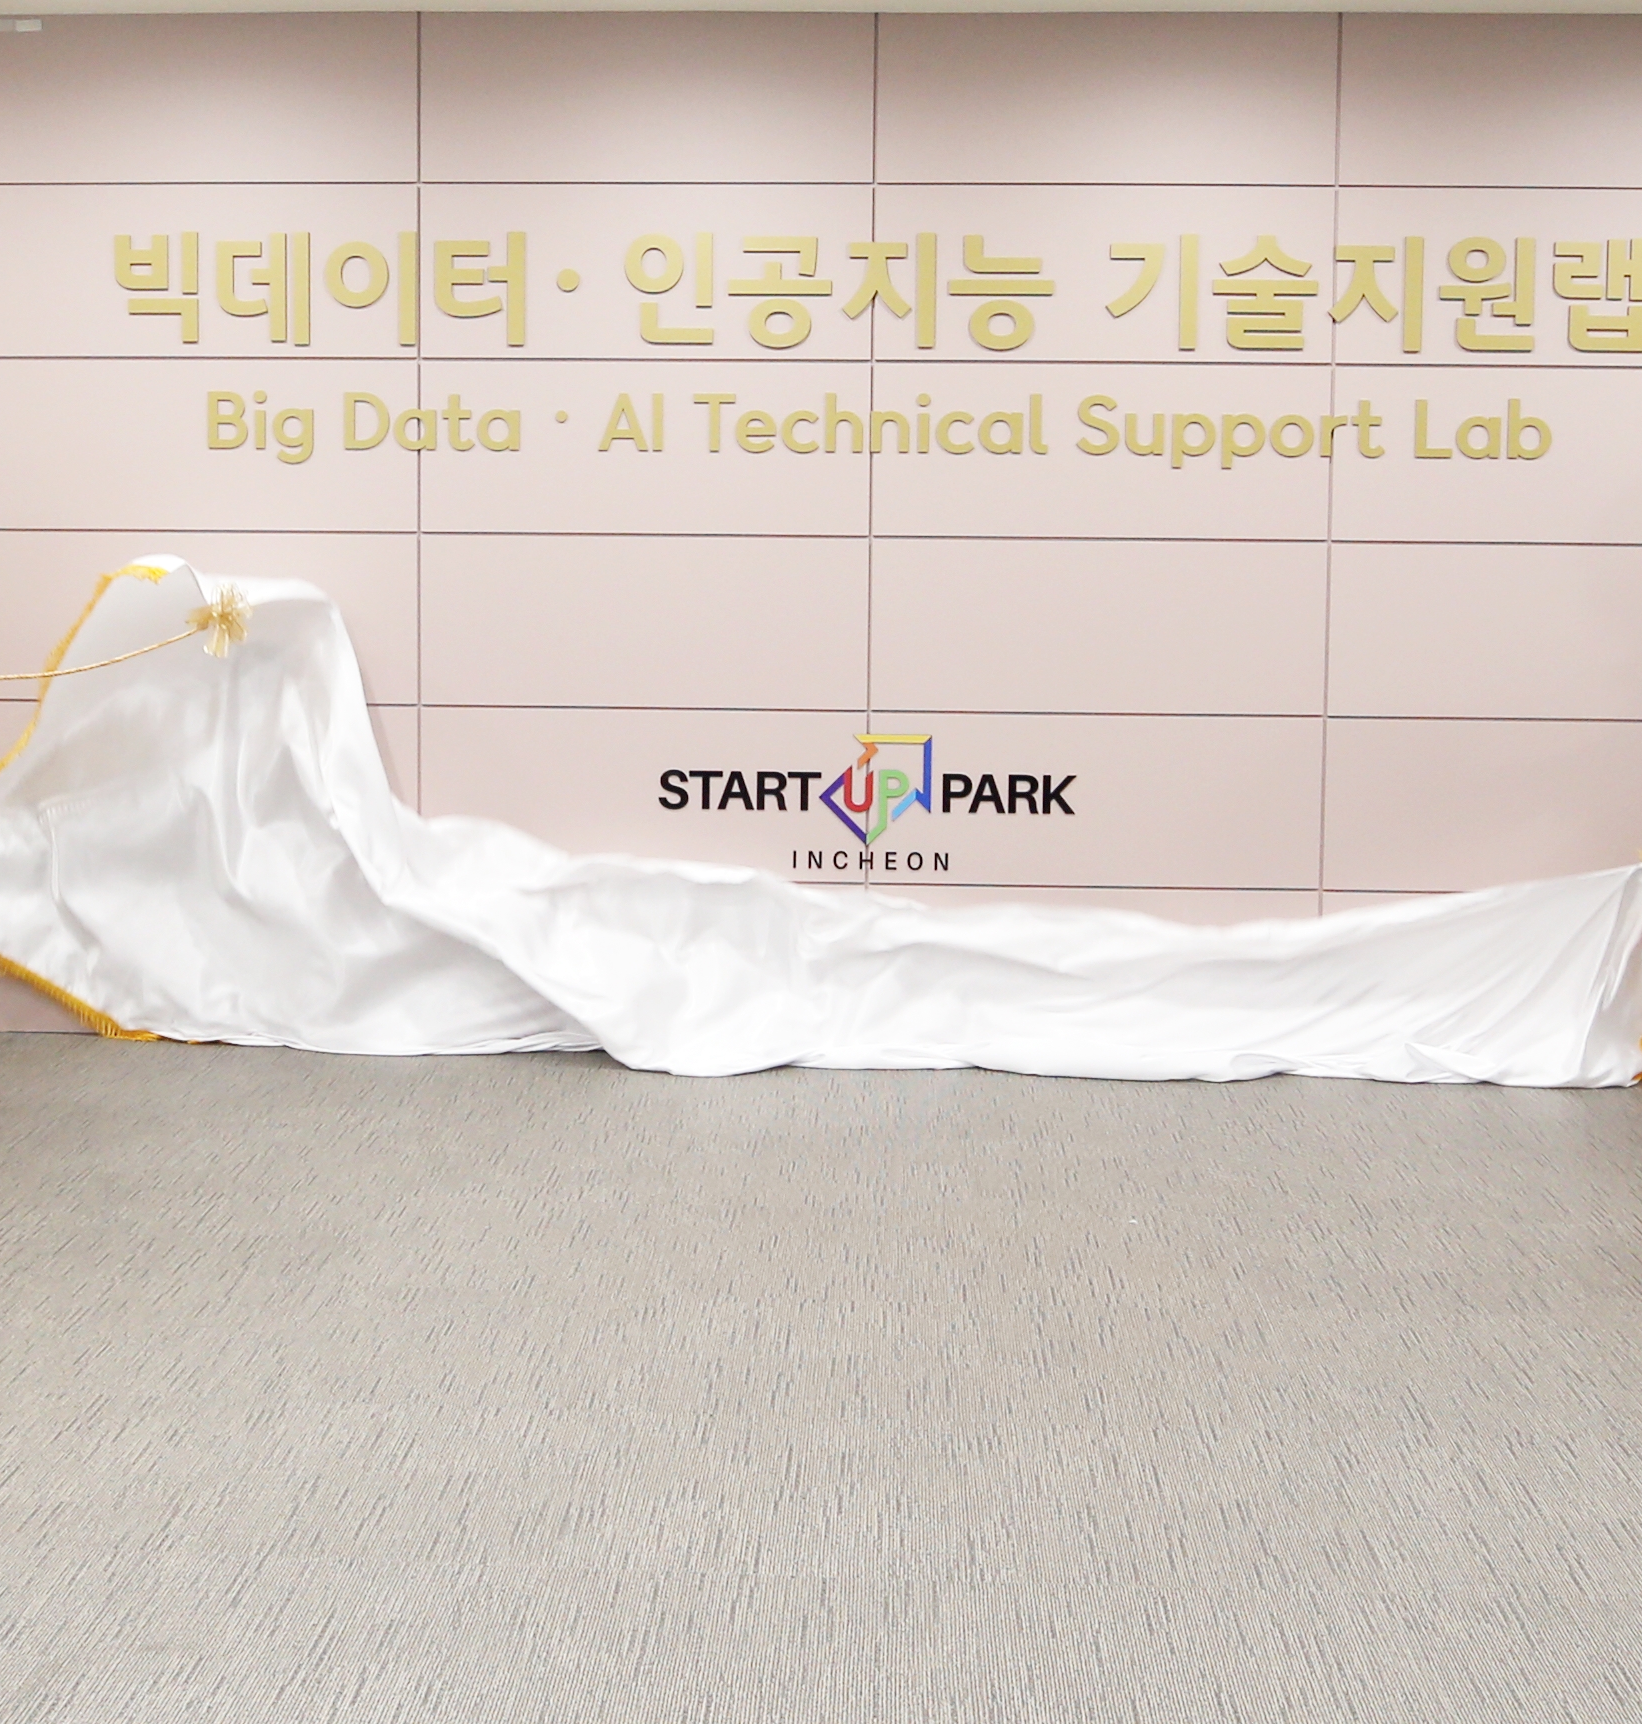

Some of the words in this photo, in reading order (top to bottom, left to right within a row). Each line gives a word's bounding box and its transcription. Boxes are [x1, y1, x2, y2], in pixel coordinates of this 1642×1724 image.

[114, 231, 526, 346] 빅데이터
[624, 232, 1055, 351] 인공지능
[207, 390, 315, 464] Big
[343, 391, 521, 452] Data
[598, 392, 665, 452] AI
[693, 391, 1049, 455] Technical
[1076, 393, 1385, 469] Support
[1414, 398, 1553, 460] Lab
[658, 769, 821, 811] START
[941, 773, 1077, 815] PARK
[792, 850, 949, 871] INCHEON
